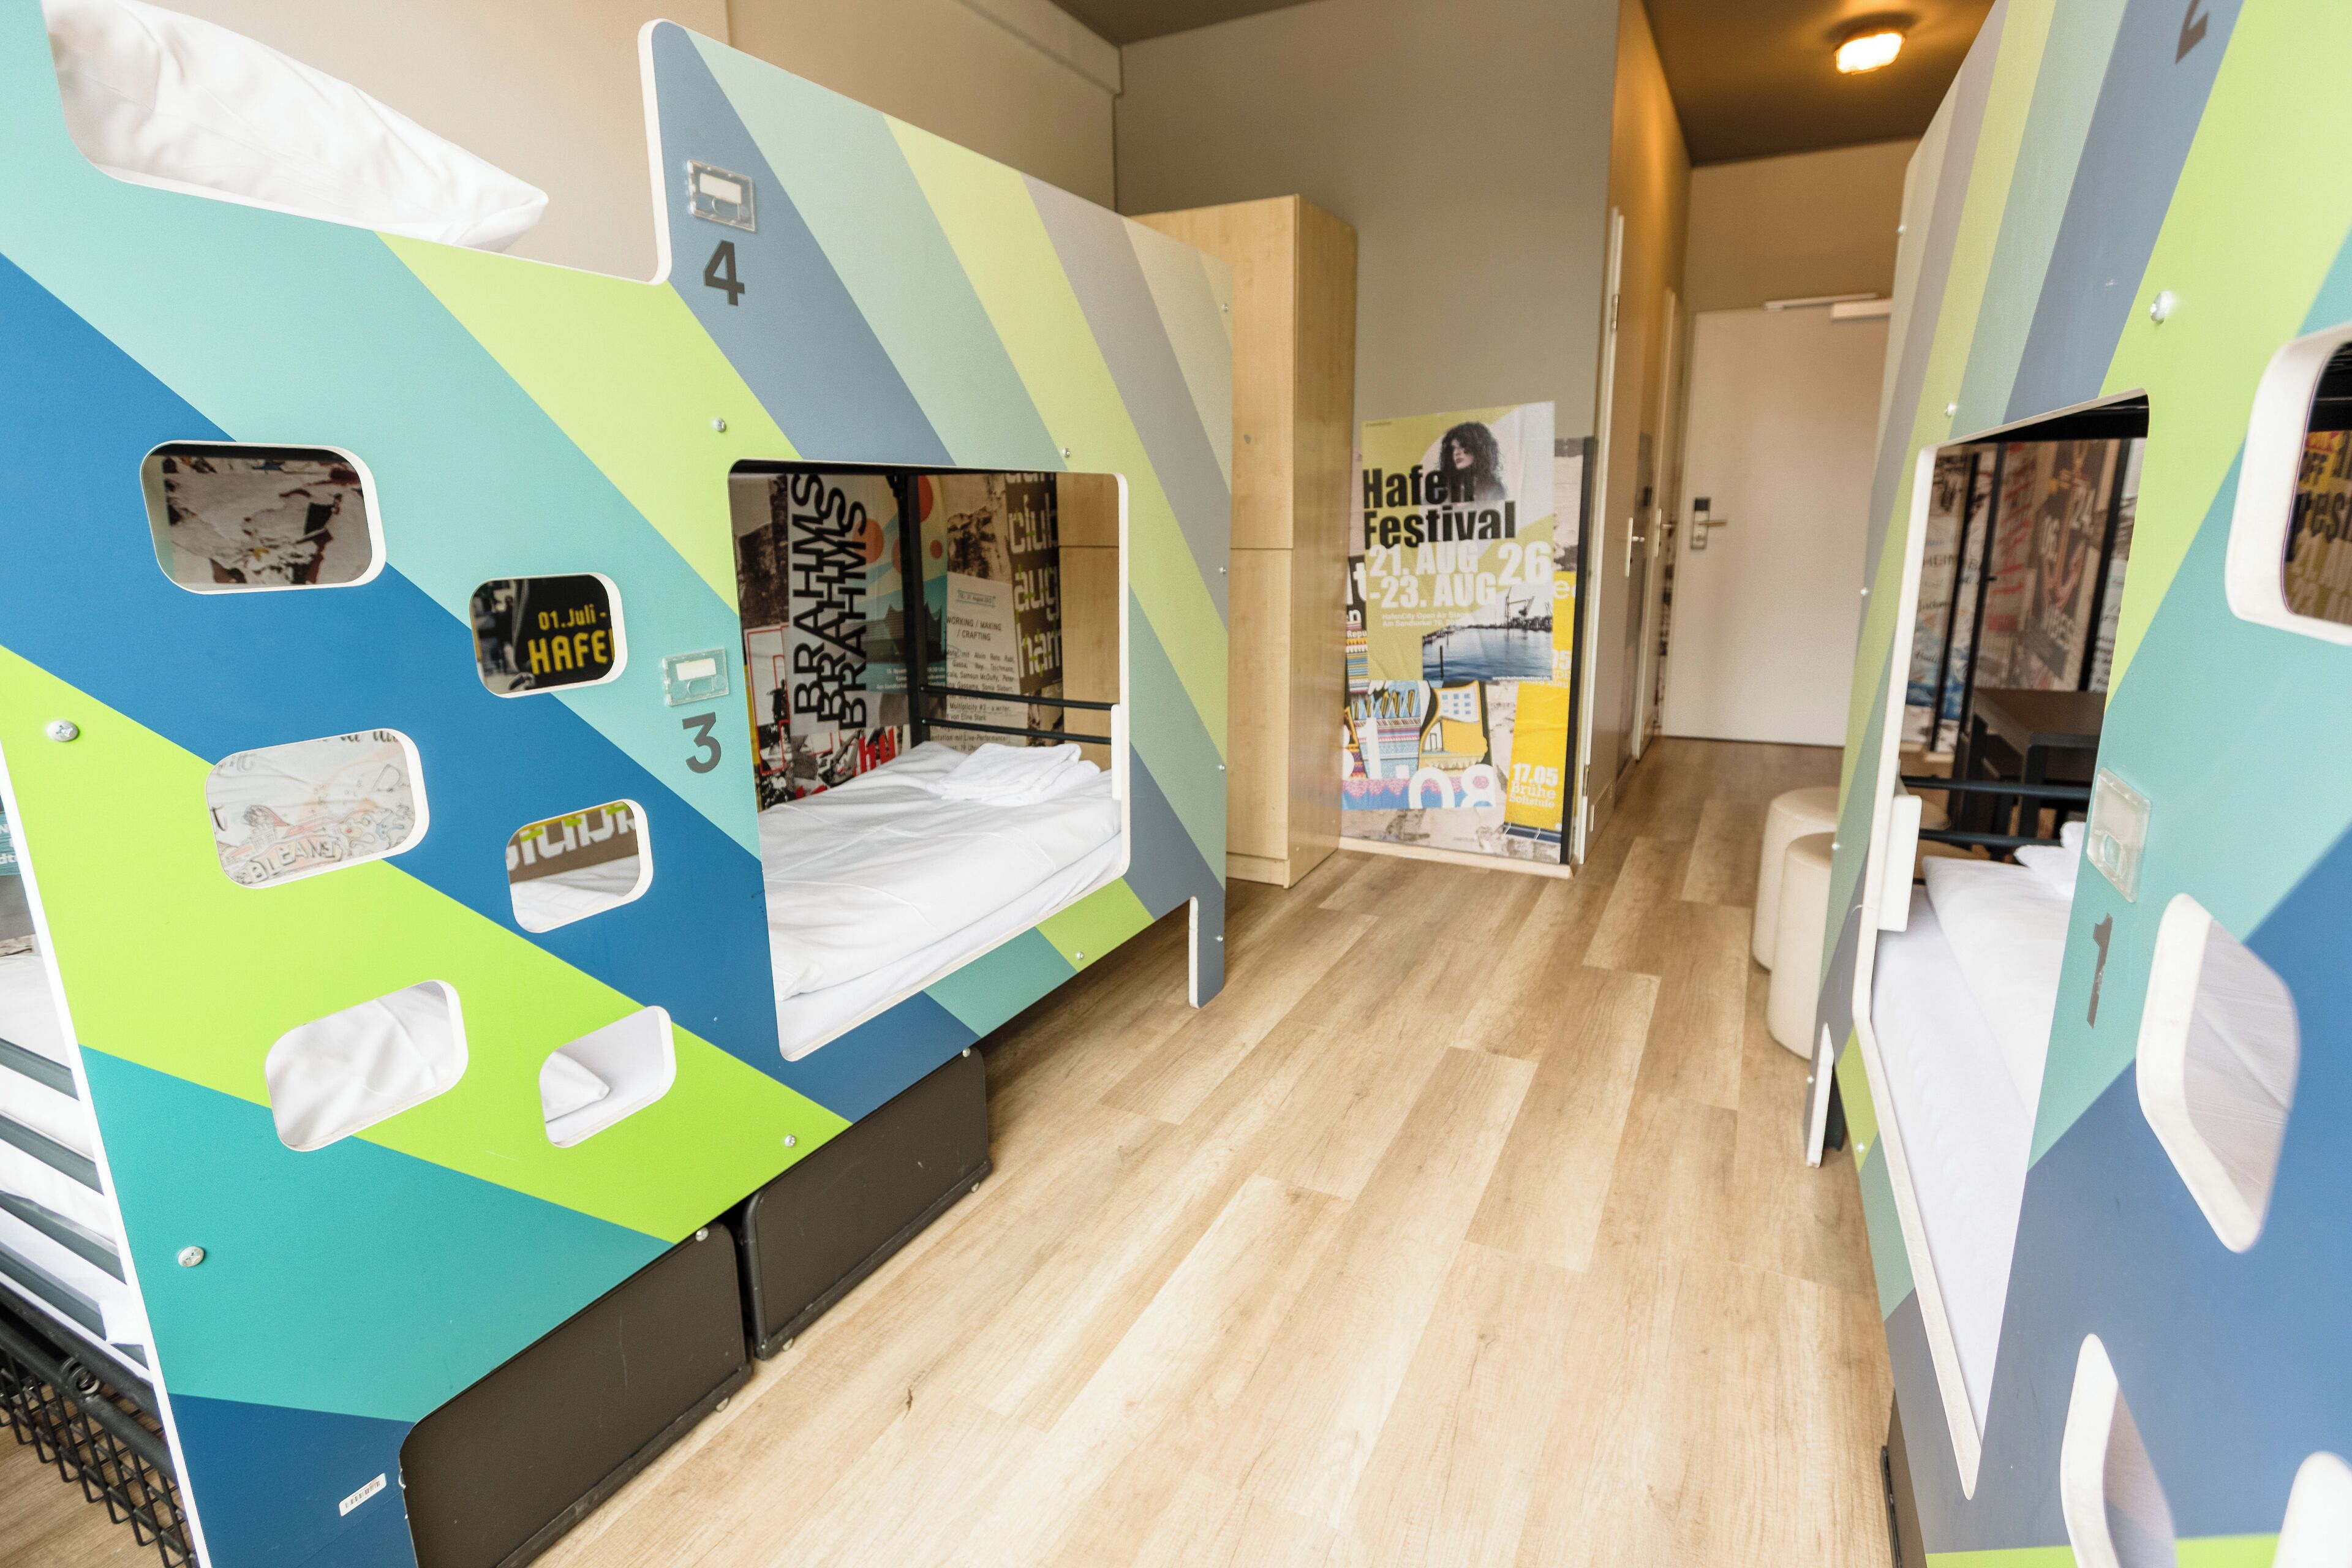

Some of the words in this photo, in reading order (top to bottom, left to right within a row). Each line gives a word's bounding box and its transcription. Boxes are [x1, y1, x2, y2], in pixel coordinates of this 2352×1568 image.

[704, 239, 745, 306] 4
[1363, 464, 1476, 508] Hafen
[1364, 500, 1517, 550] Festival
[1369, 544, 1409, 576] 21.
[1416, 539, 1479, 575] AUG
[1498, 541, 1552, 586] 26
[791, 474, 824, 714] BRAHMS
[815, 488, 846, 722] BRAHMS
[1433, 571, 1498, 608] AUG
[538, 603, 596, 631] 01.Juli
[837, 501, 867, 730] BRAHMS
[947, 615, 974, 627] WORKING
[980, 620, 1002, 631] MAKING
[961, 629, 990, 641] CRAFTING
[682, 712, 722, 774] 3
[1510, 781, 1557, 801] Brühe
[1512, 762, 1559, 787] 17.05
[2088, 913, 2113, 1029] 1
